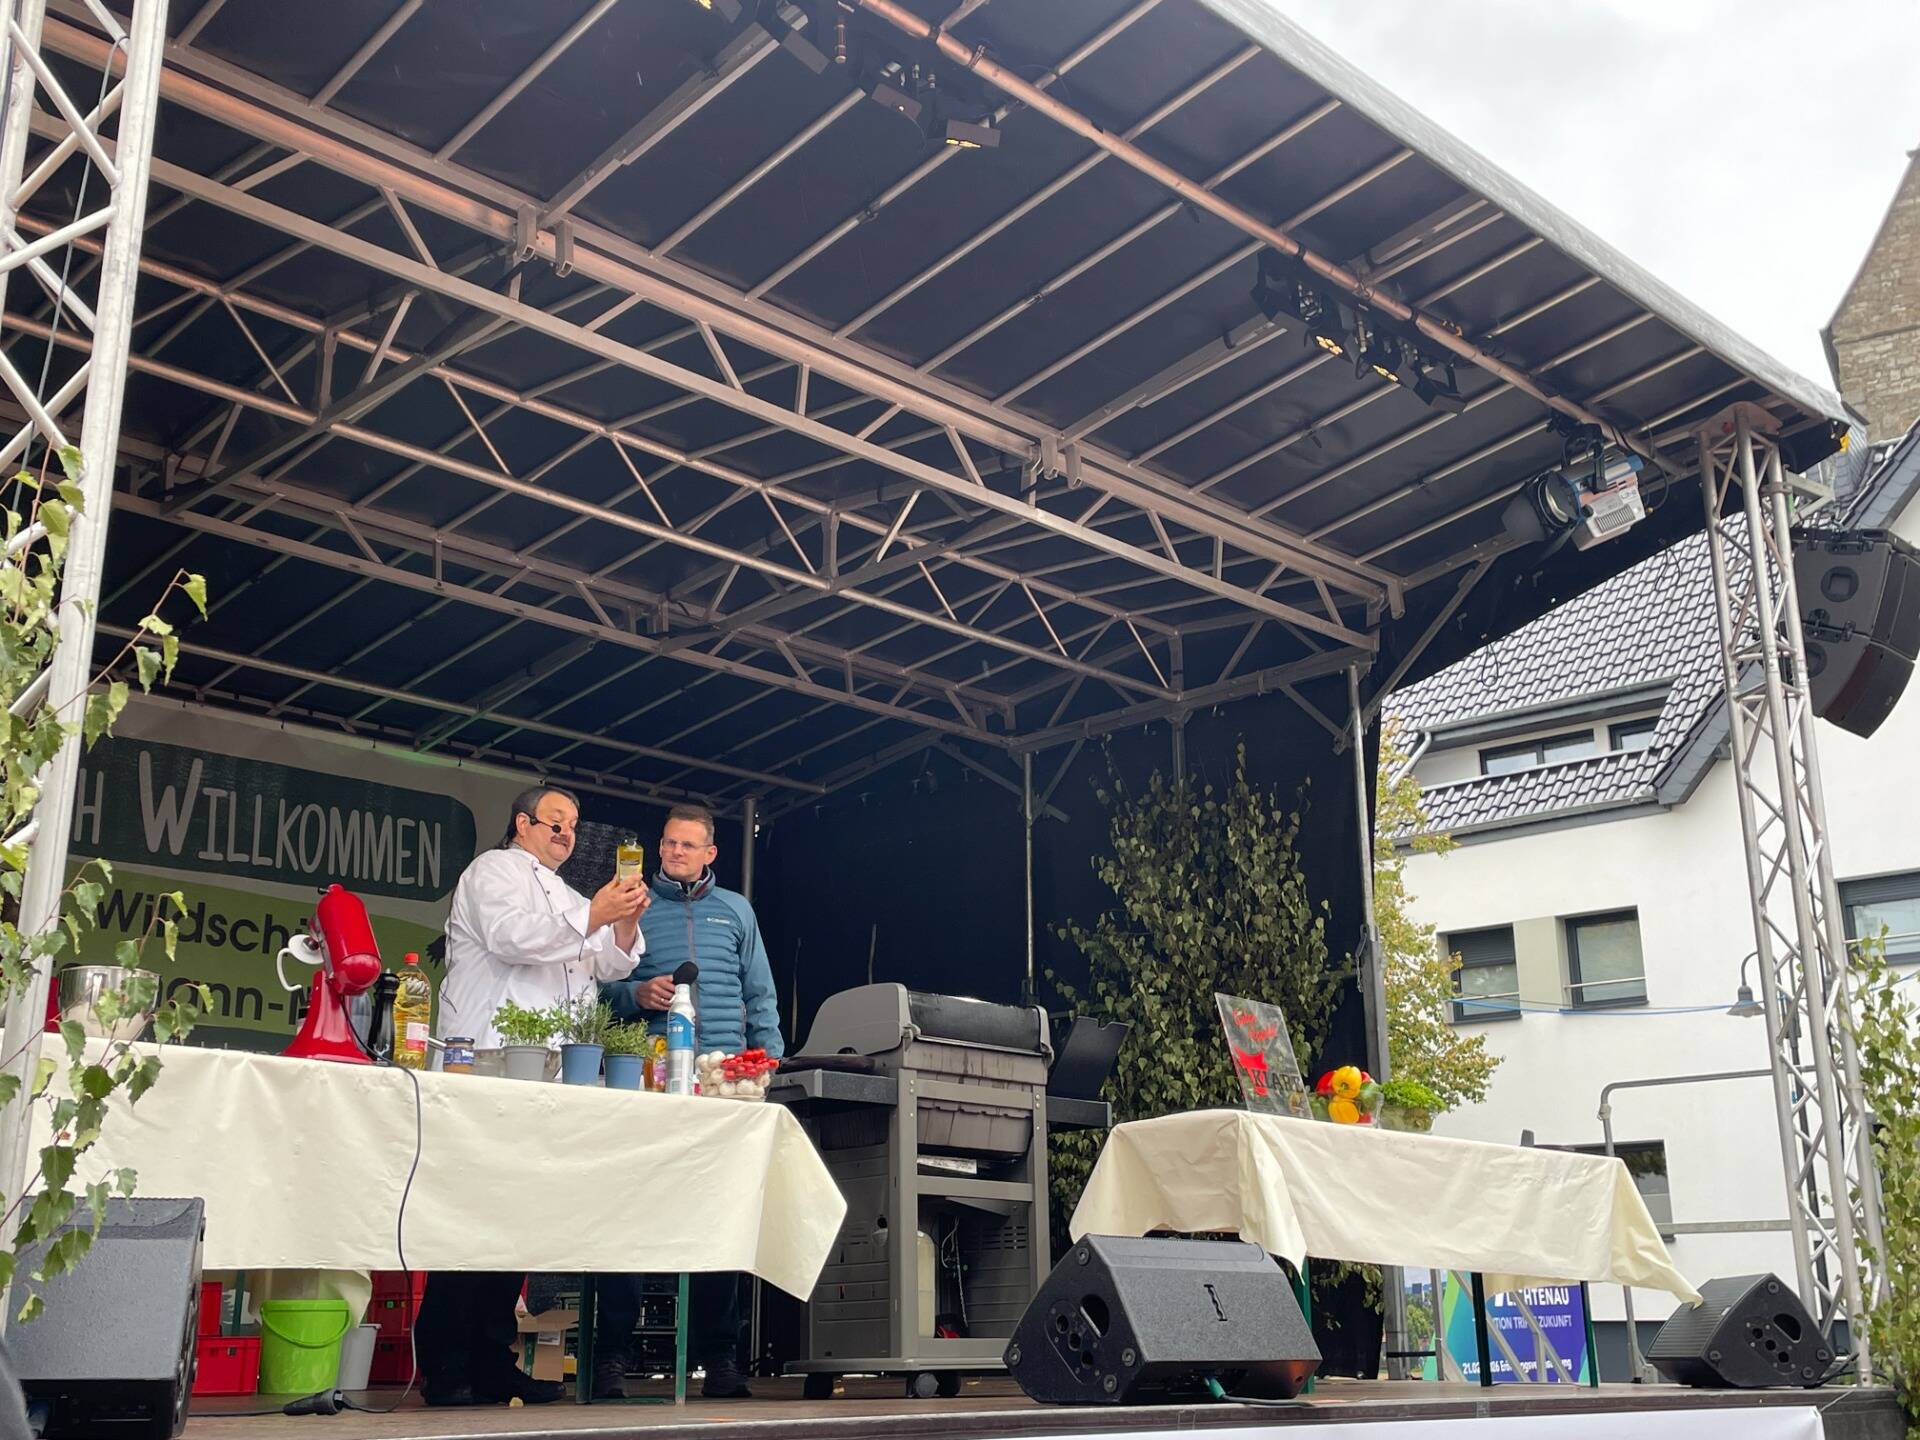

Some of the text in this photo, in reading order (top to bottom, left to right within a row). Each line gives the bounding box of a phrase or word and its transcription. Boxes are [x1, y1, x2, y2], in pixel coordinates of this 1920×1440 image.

[139, 750, 441, 888] WILLKOMMEN
[97, 887, 308, 957] Wildsch
[1506, 1287, 1570, 1306] LHTENAU
[1538, 1314, 1573, 1328] ZUKUNFT
